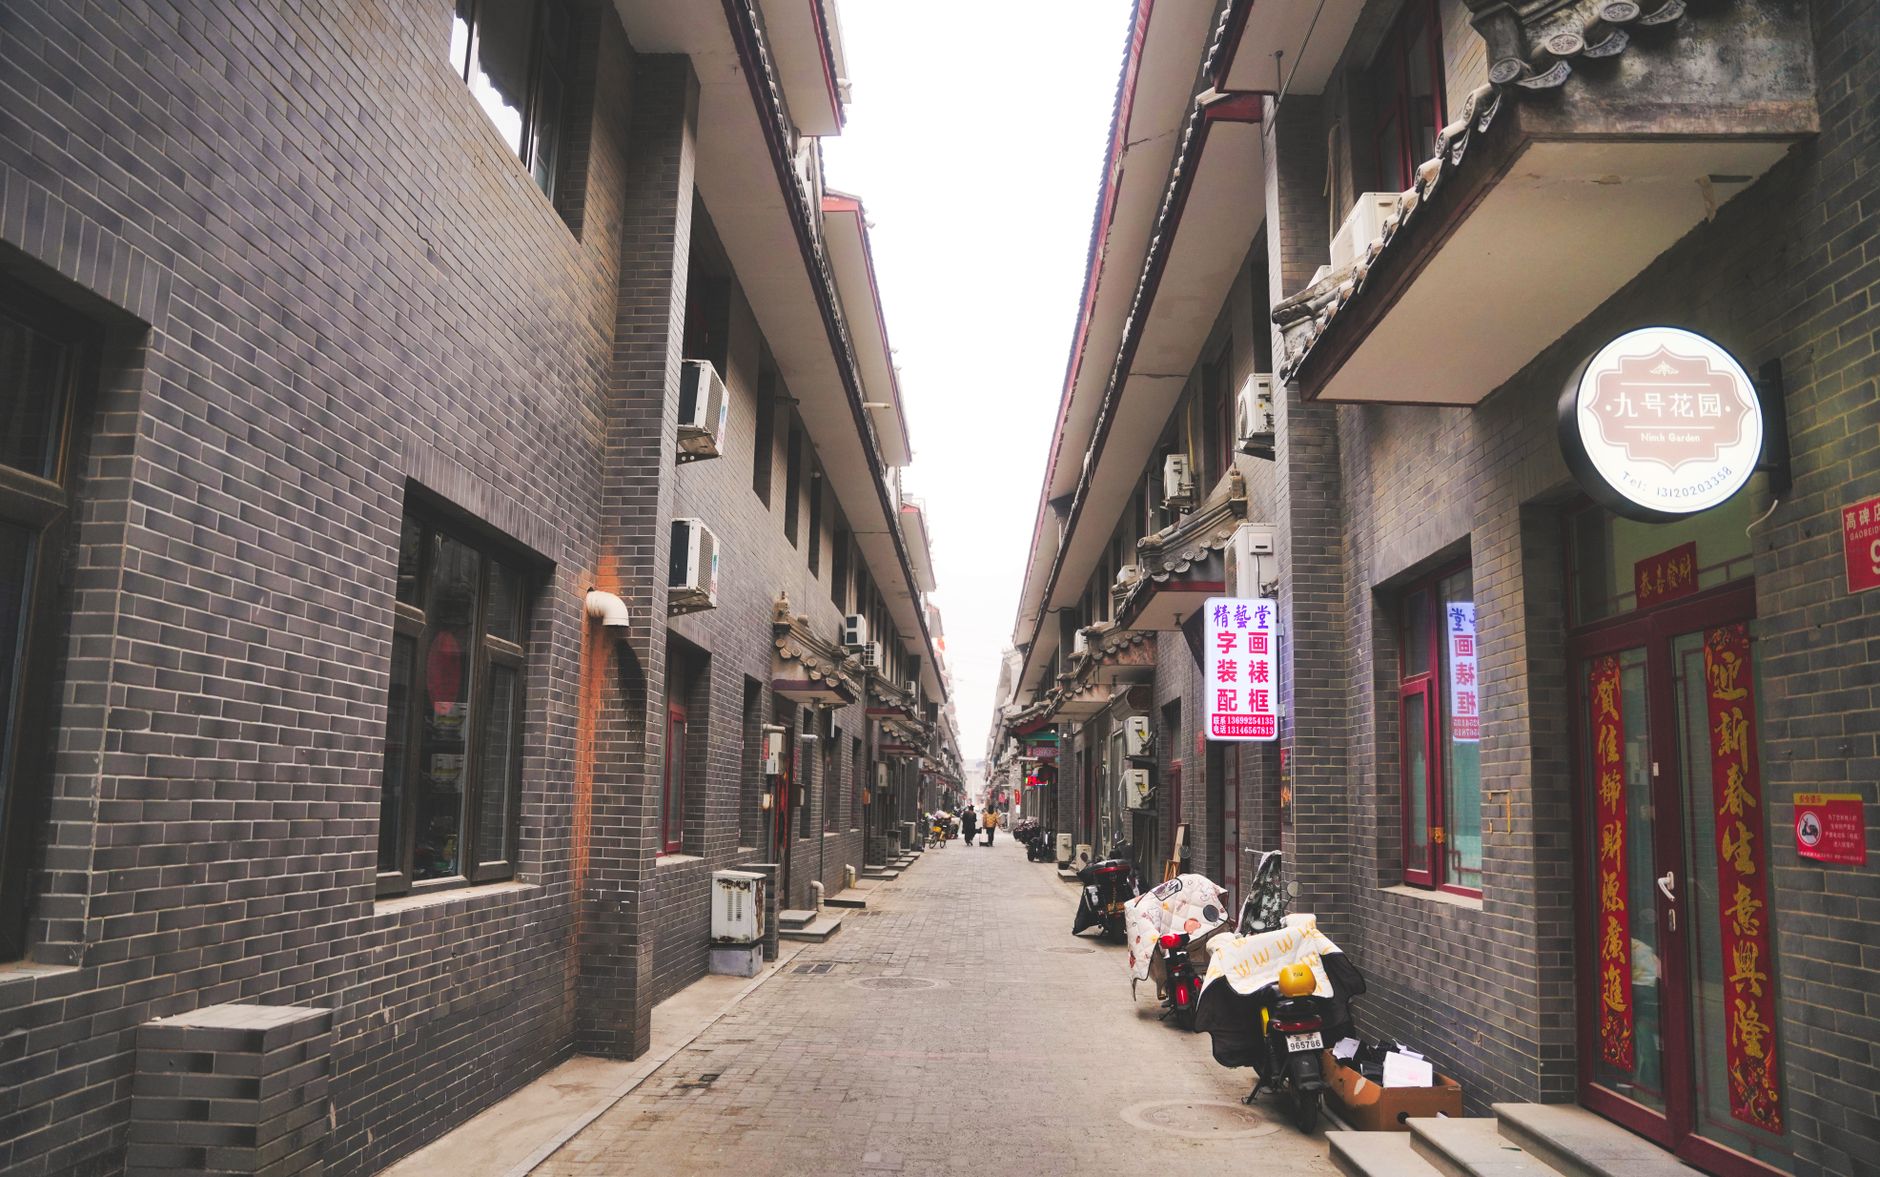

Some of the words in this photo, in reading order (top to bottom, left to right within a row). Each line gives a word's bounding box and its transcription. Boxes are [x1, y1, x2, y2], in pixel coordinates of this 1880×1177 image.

[1613, 391, 1722, 419] 九号花园
[1668, 432, 1701, 442] Garden
[1622, 470, 1647, 492] Tel:
[1656, 465, 1733, 498] 13120203358
[1213, 604, 1271, 629] 精藝堂
[1227, 716, 1274, 725] 13699254135
[1227, 726, 1274, 735] 13146567813
[1290, 1040, 1321, 1050] 965786
